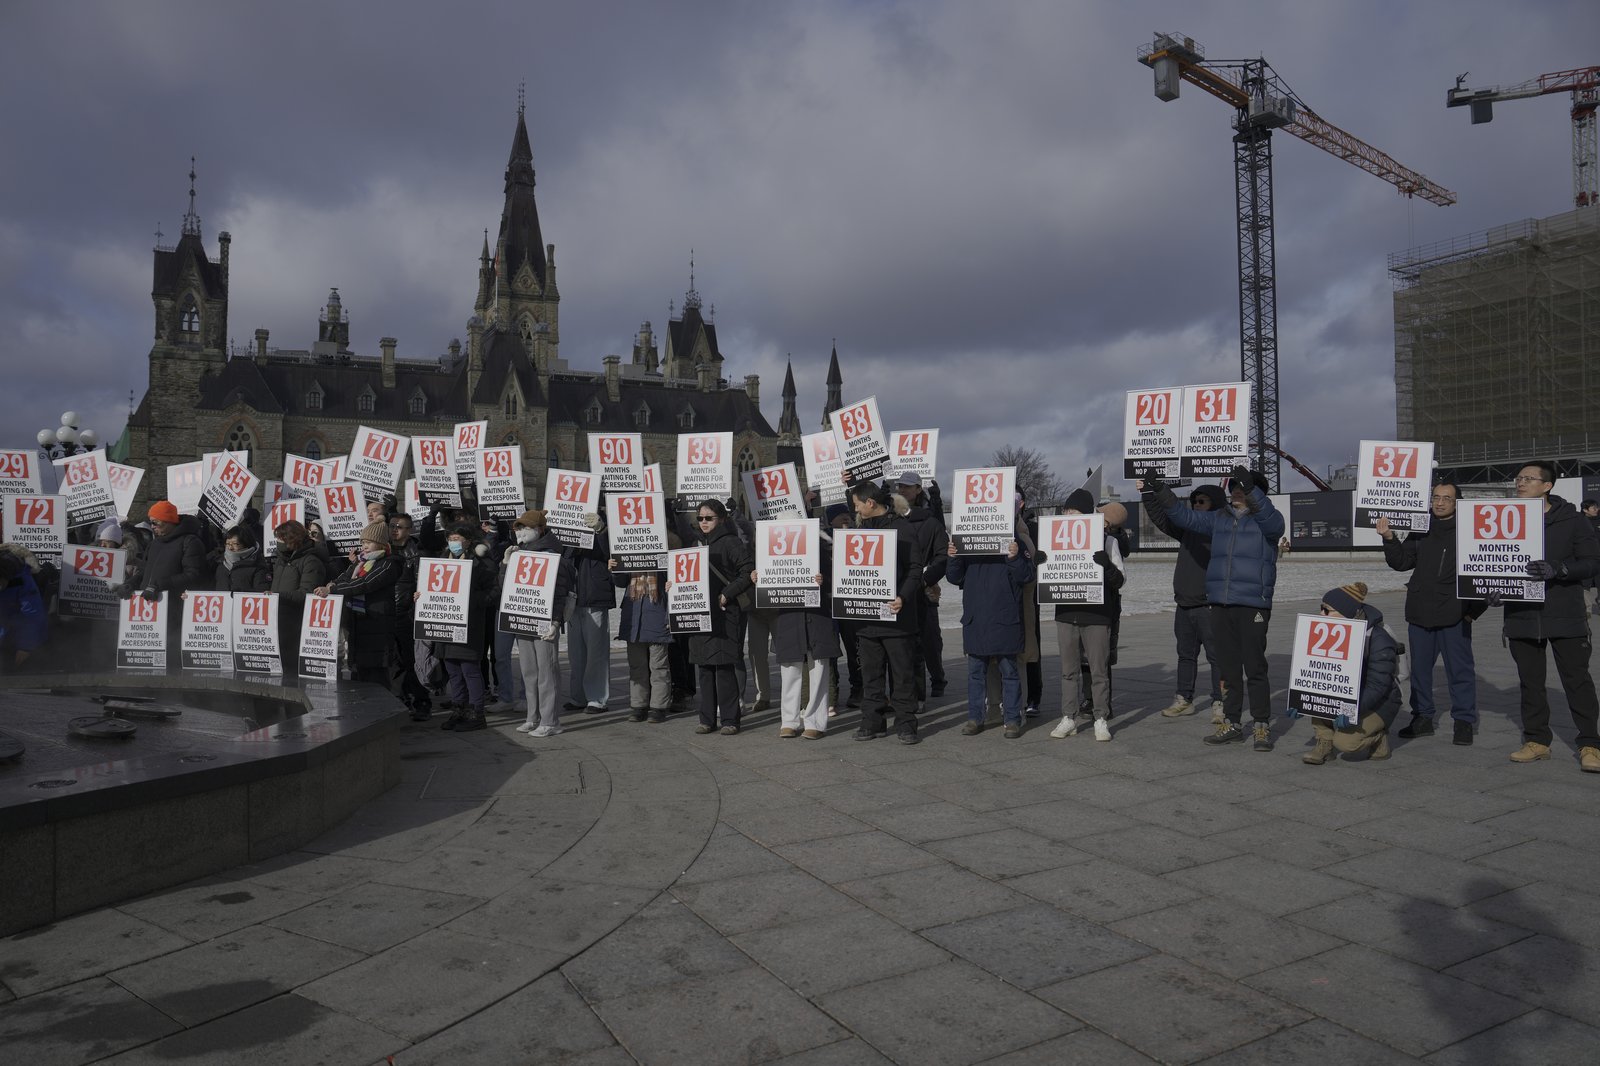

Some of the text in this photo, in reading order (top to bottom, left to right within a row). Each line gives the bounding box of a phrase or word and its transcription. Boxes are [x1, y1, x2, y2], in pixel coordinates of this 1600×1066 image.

[1139, 393, 1166, 424] 20
[1199, 388, 1232, 421] 31
[842, 405, 870, 436] 38
[1138, 428, 1164, 436] MONTHS
[1198, 425, 1230, 433] MONTHS
[368, 434, 395, 460] 70
[460, 426, 477, 448] 28
[845, 440, 879, 457] WAITING FOR
[848, 434, 871, 448] MONTHS
[901, 433, 925, 455] 41
[1189, 435, 1221, 443] WAITING
[1202, 444, 1242, 452] RESPONSE
[422, 440, 444, 465] 36
[601, 438, 629, 463] 90
[691, 437, 716, 463] 39
[844, 446, 884, 466] IRCC RESPONSE
[1141, 446, 1175, 454] RESPONSE
[1377, 446, 1413, 477] 37
[0, 454, 24, 478] 29
[68, 460, 95, 484] 63
[362, 458, 388, 470] MONTHS
[486, 450, 509, 476] 28
[224, 464, 247, 493] 35
[296, 463, 318, 488] 16
[758, 470, 786, 498] 32
[1376, 480, 1411, 488] MONTHS
[71, 482, 96, 493] MONTHS
[326, 486, 354, 512] 31
[559, 474, 586, 502] 37
[969, 473, 998, 502] 38
[1366, 488, 1400, 497] WAITING
[20, 499, 49, 524] 72
[621, 496, 650, 524] 31
[763, 498, 788, 508] MONTHS
[1380, 498, 1424, 508] RESPONSE
[1479, 504, 1520, 538] 30
[773, 526, 802, 554] 37
[1055, 519, 1085, 549] 40
[849, 534, 879, 565] 37
[1468, 553, 1531, 562] WAITING FOR
[1478, 543, 1520, 552] MONTHS
[79, 551, 109, 577] 23
[518, 556, 545, 585] 37
[677, 552, 697, 582] 37
[848, 569, 878, 577] MONTHS
[1462, 563, 1483, 572] IRCC
[430, 564, 457, 592] 37
[841, 578, 870, 586] WAITING
[429, 595, 454, 603] MONTHS
[508, 594, 546, 606] WAITING FOR
[515, 587, 540, 596] MONTHS
[853, 587, 891, 596] RESPONSE
[131, 597, 154, 620] 18
[195, 596, 220, 622] 36
[243, 598, 265, 624] 21
[311, 600, 331, 627] 14
[422, 602, 447, 611] WAITING
[1311, 621, 1346, 659] 22
[1299, 668, 1350, 684] WAITING FOR
[1308, 659, 1342, 672] MONTHS
[1294, 678, 1353, 695] IRCC RESPONSE
[1299, 693, 1309, 702] NO
[1302, 702, 1340, 716] NO RESULTS
